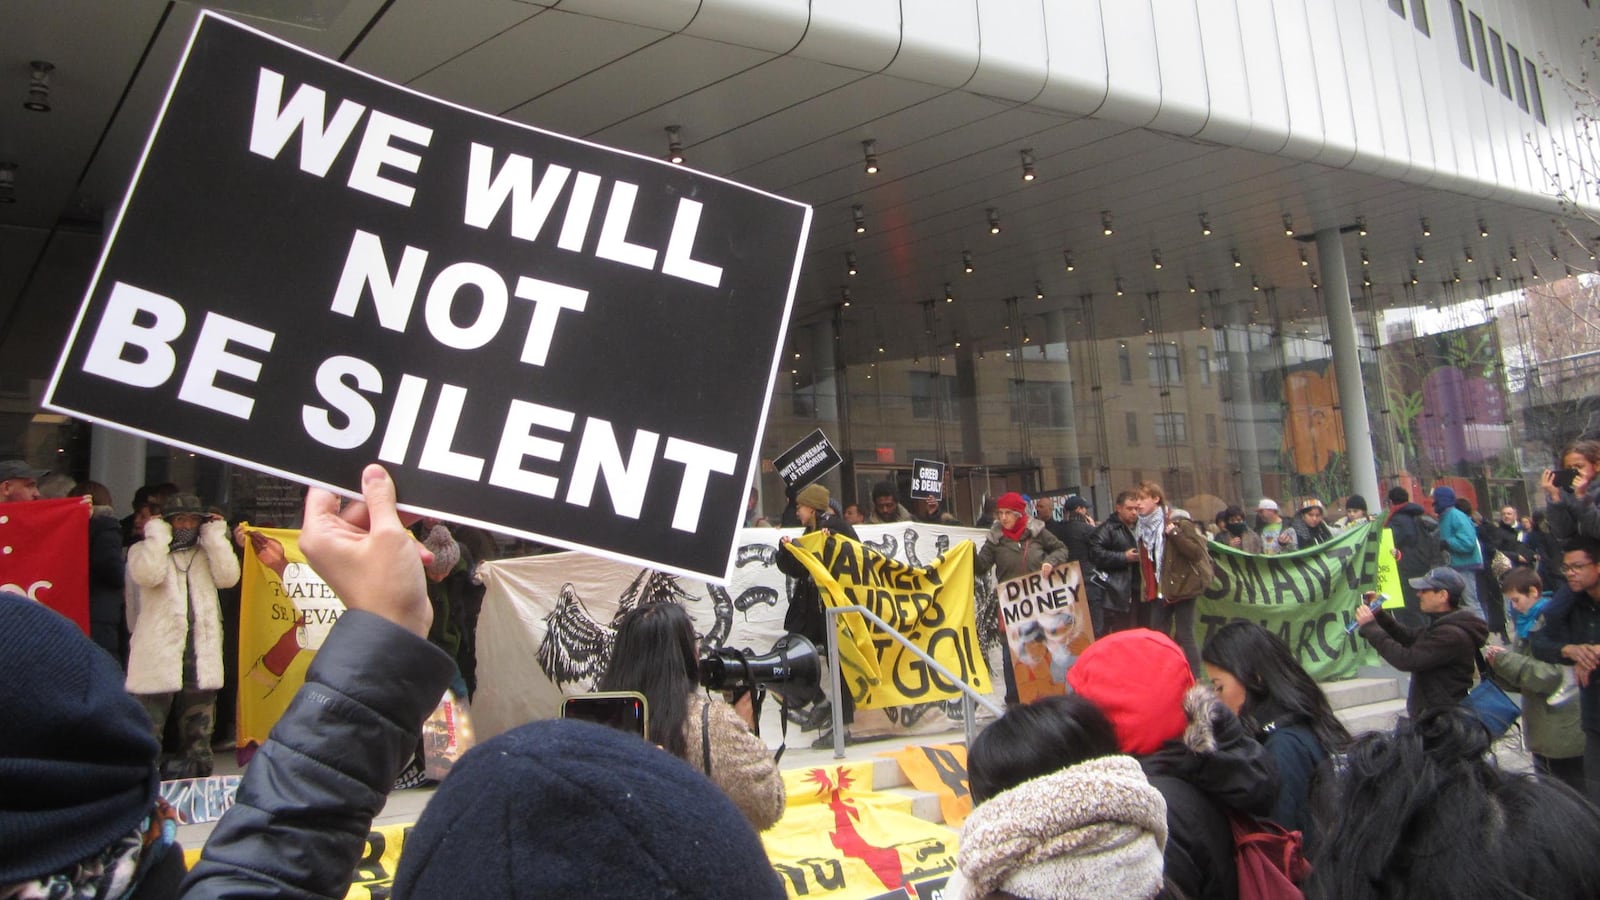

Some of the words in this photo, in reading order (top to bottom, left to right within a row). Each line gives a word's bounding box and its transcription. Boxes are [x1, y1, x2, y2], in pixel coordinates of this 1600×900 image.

[249, 67, 434, 208] WE
[463, 142, 724, 289] WILL
[330, 230, 590, 367] NOT
[82, 281, 276, 420] BE
[301, 355, 739, 534] SILENT
[780, 461, 798, 478] WHITE
[795, 439, 828, 467] SUPREMACY
[789, 472, 798, 481] IS
[796, 450, 828, 477] TERRORISM
[919, 467, 939, 480] GREED
[912, 479, 920, 490] IS
[920, 480, 943, 492] DEADLY
[1006, 567, 1068, 601] DIRTY
[1204, 531, 1377, 605] SMANTLE
[269, 580, 341, 599] GUATE
[1003, 584, 1080, 624] MONEY
[271, 604, 289, 621] SE
[292, 608, 348, 625] LEVA
